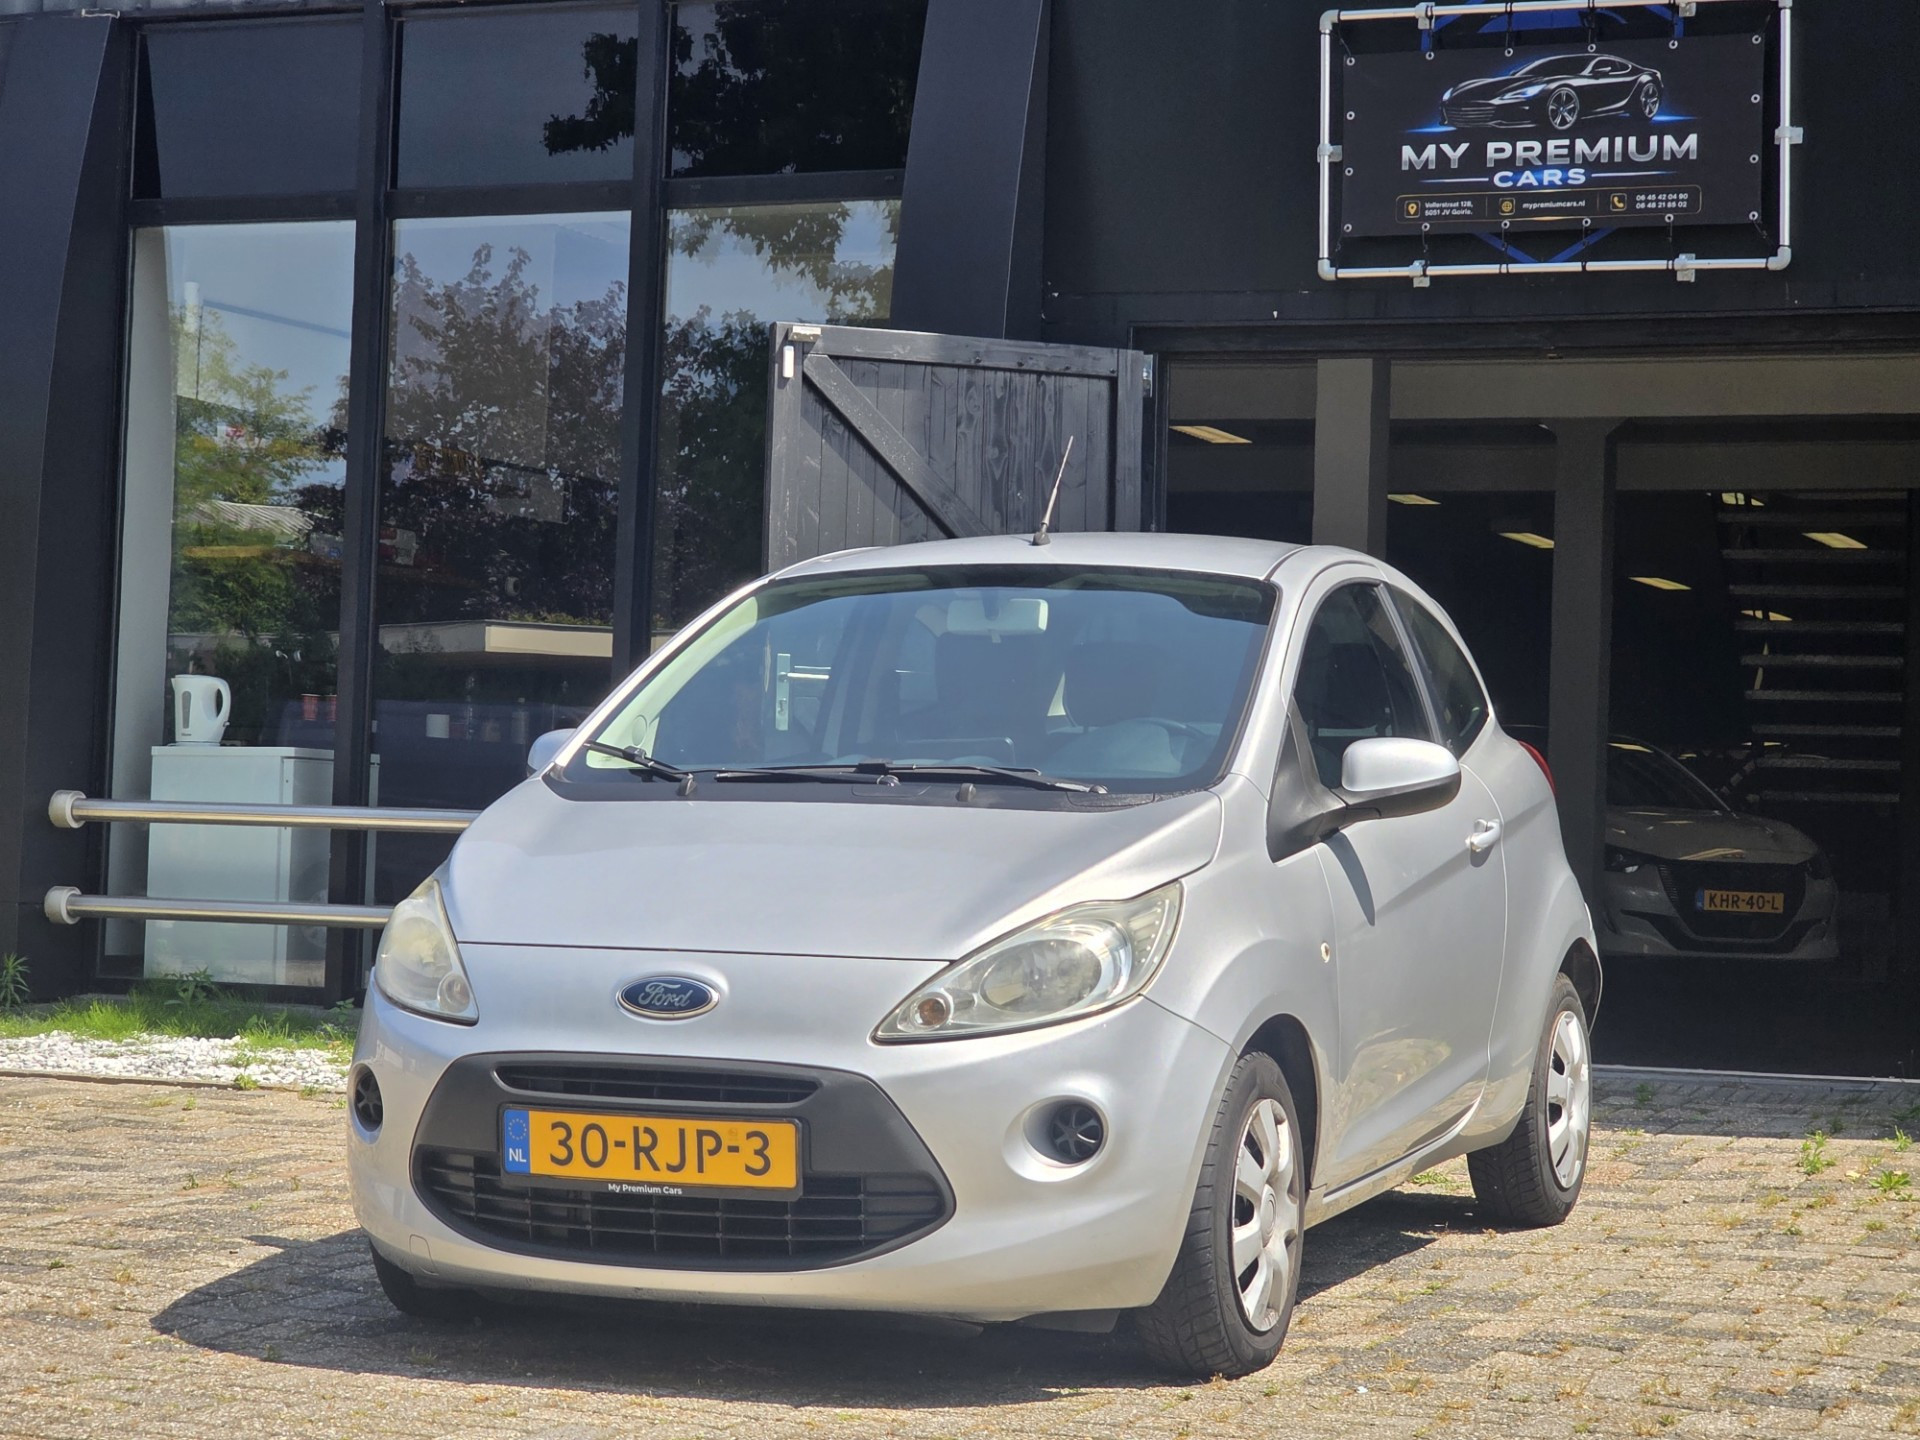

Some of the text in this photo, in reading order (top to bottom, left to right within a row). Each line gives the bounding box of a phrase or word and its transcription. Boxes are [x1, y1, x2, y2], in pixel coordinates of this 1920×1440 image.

[1401, 133, 1698, 171] MY PREMIUM
[1493, 168, 1587, 188] CARS
[1522, 200, 1586, 210] mypremiumcars.nl
[1708, 892, 1780, 911] KHR-40-L
[638, 981, 691, 1007] Ford
[508, 1120, 772, 1177] NL 30-RJP-3
[608, 1183, 683, 1195] My Premium Cars
